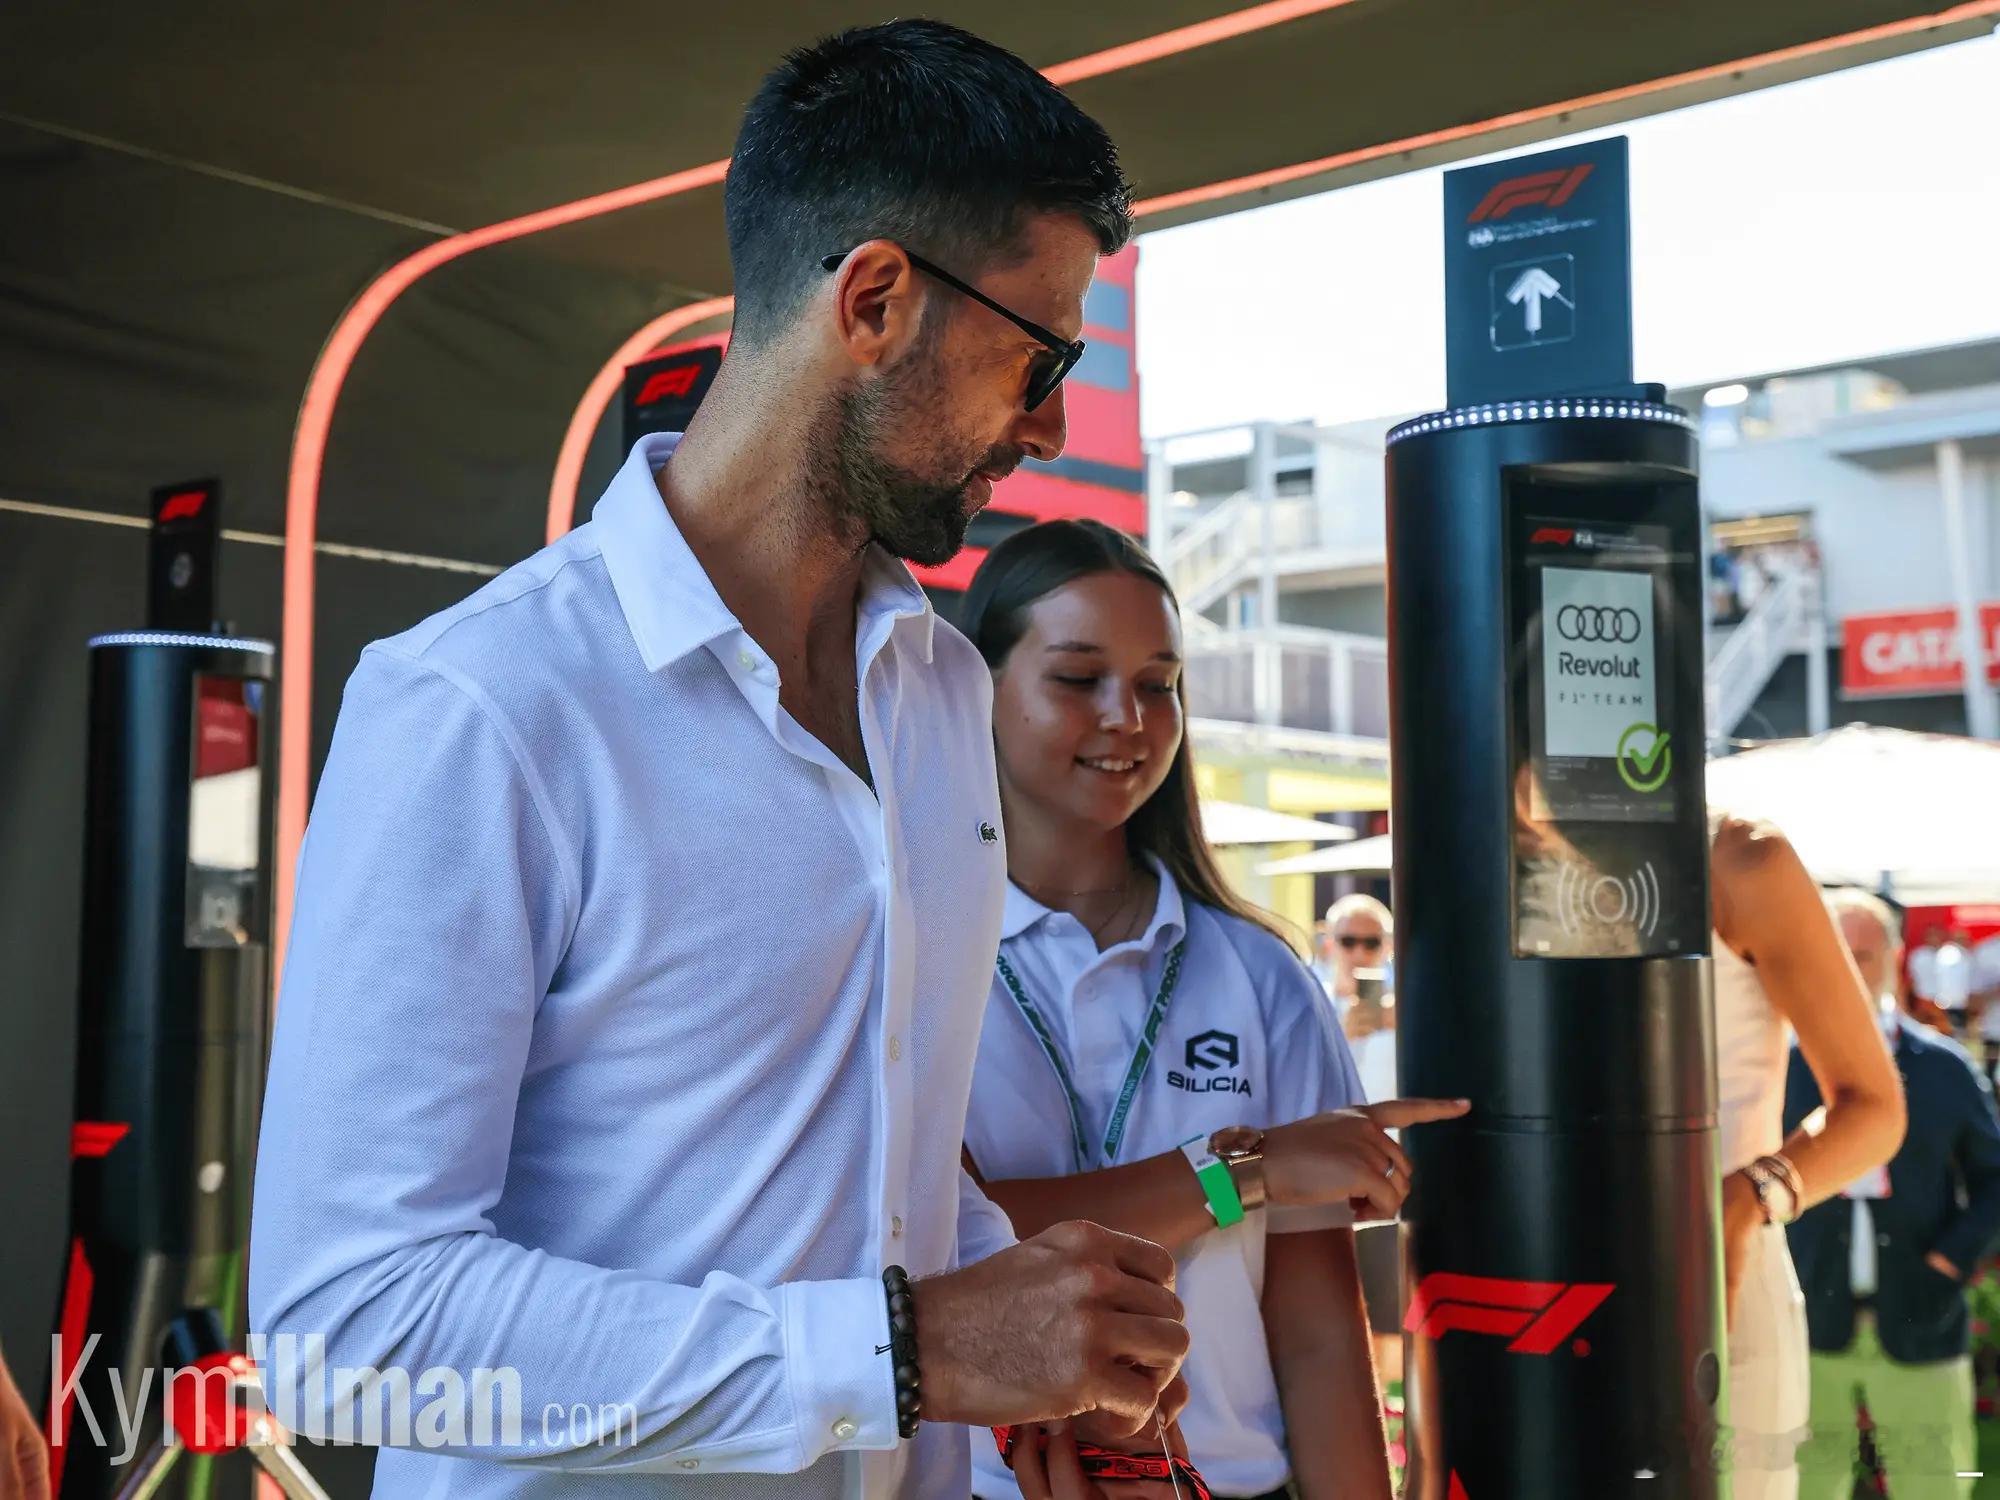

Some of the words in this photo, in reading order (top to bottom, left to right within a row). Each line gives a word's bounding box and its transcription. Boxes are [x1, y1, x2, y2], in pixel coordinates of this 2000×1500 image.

[1559, 651, 1641, 679] Revolut
[1593, 691, 1643, 705] TEAM
[1167, 1070, 1252, 1098] SILICIA
[1403, 1271, 1617, 1354] F1
